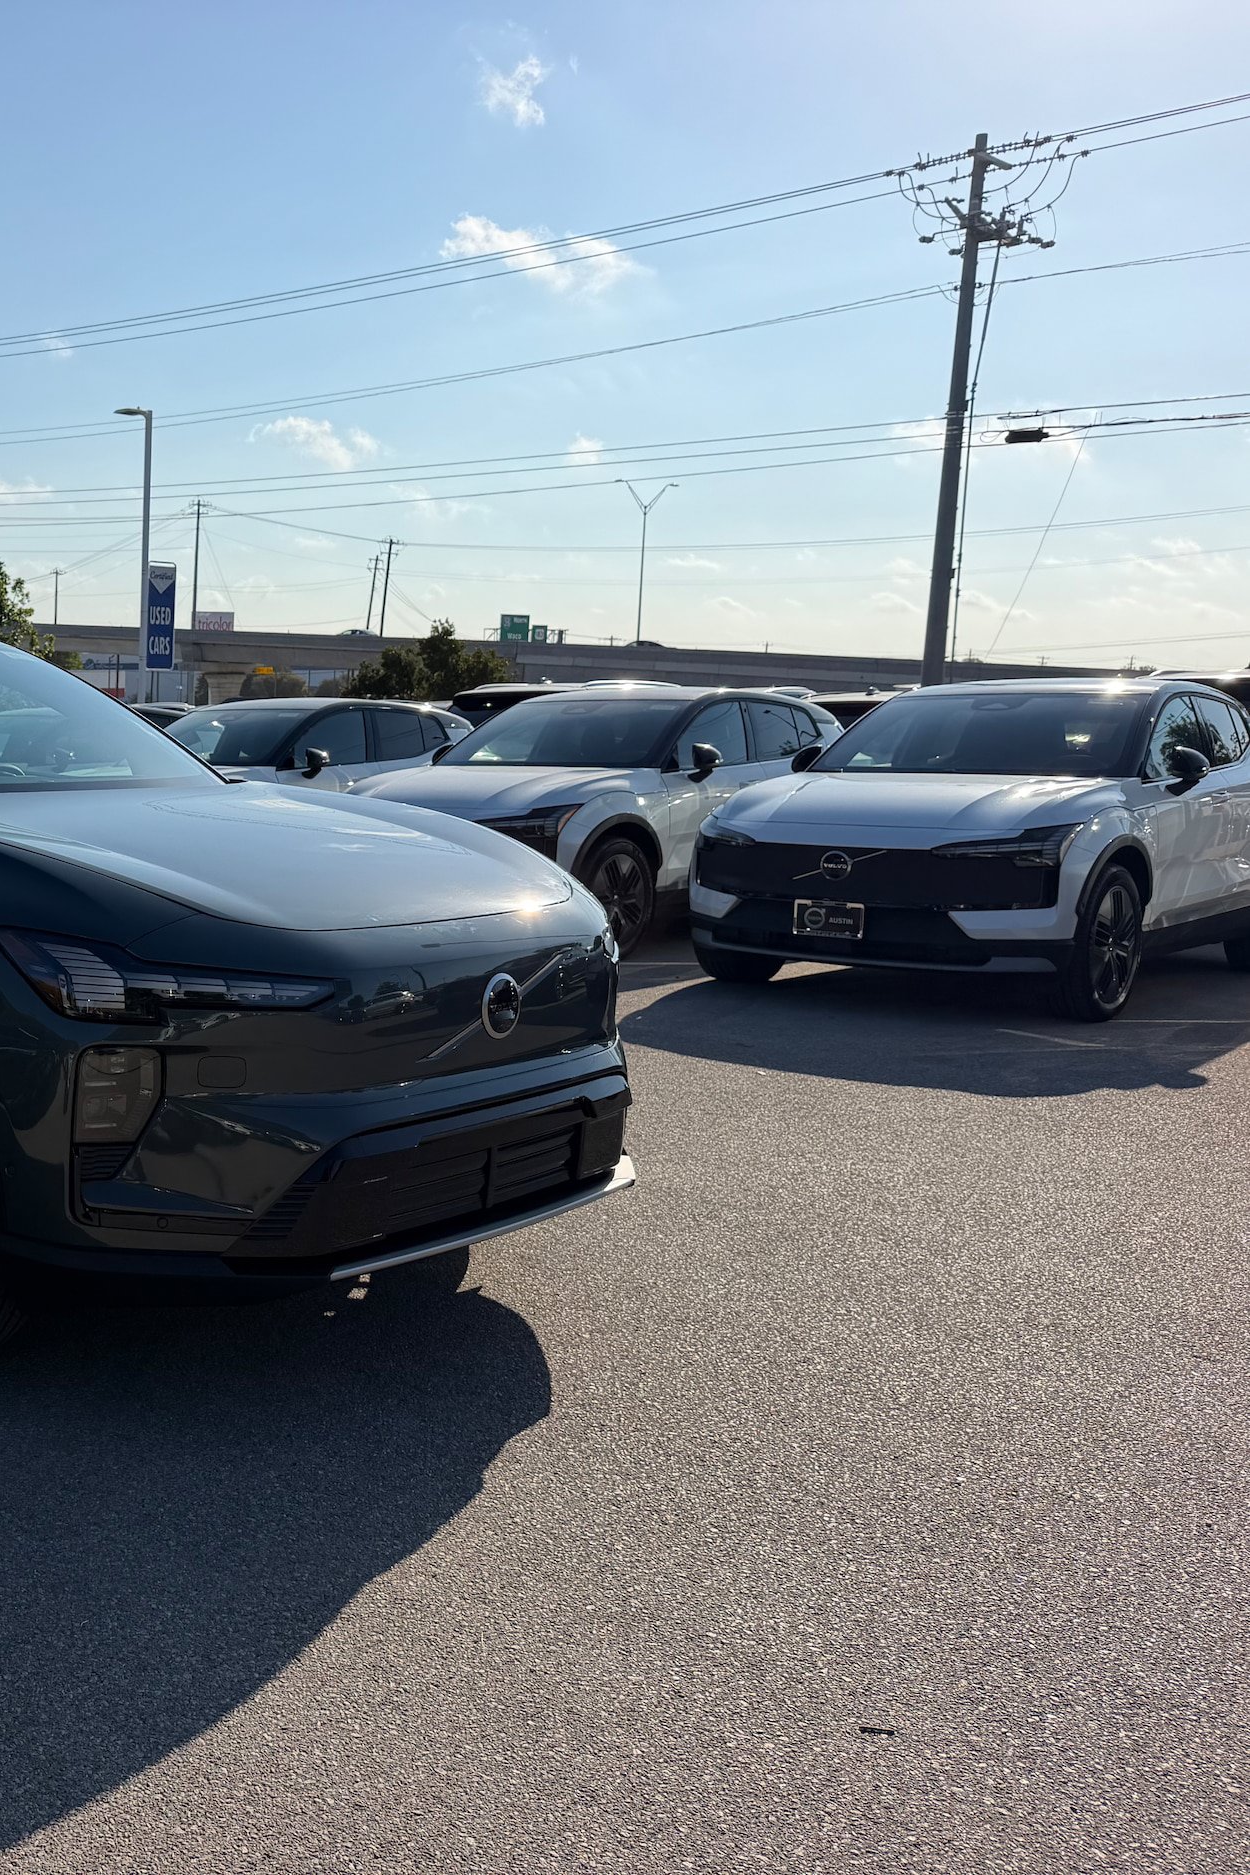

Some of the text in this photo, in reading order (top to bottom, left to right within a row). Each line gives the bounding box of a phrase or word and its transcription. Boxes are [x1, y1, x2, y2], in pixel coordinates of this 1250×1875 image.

[150, 606, 171, 625] USED
[149, 636, 170, 655] CARS
[823, 862, 847, 870] VOLVO
[828, 917, 854, 925] AUSTIN
